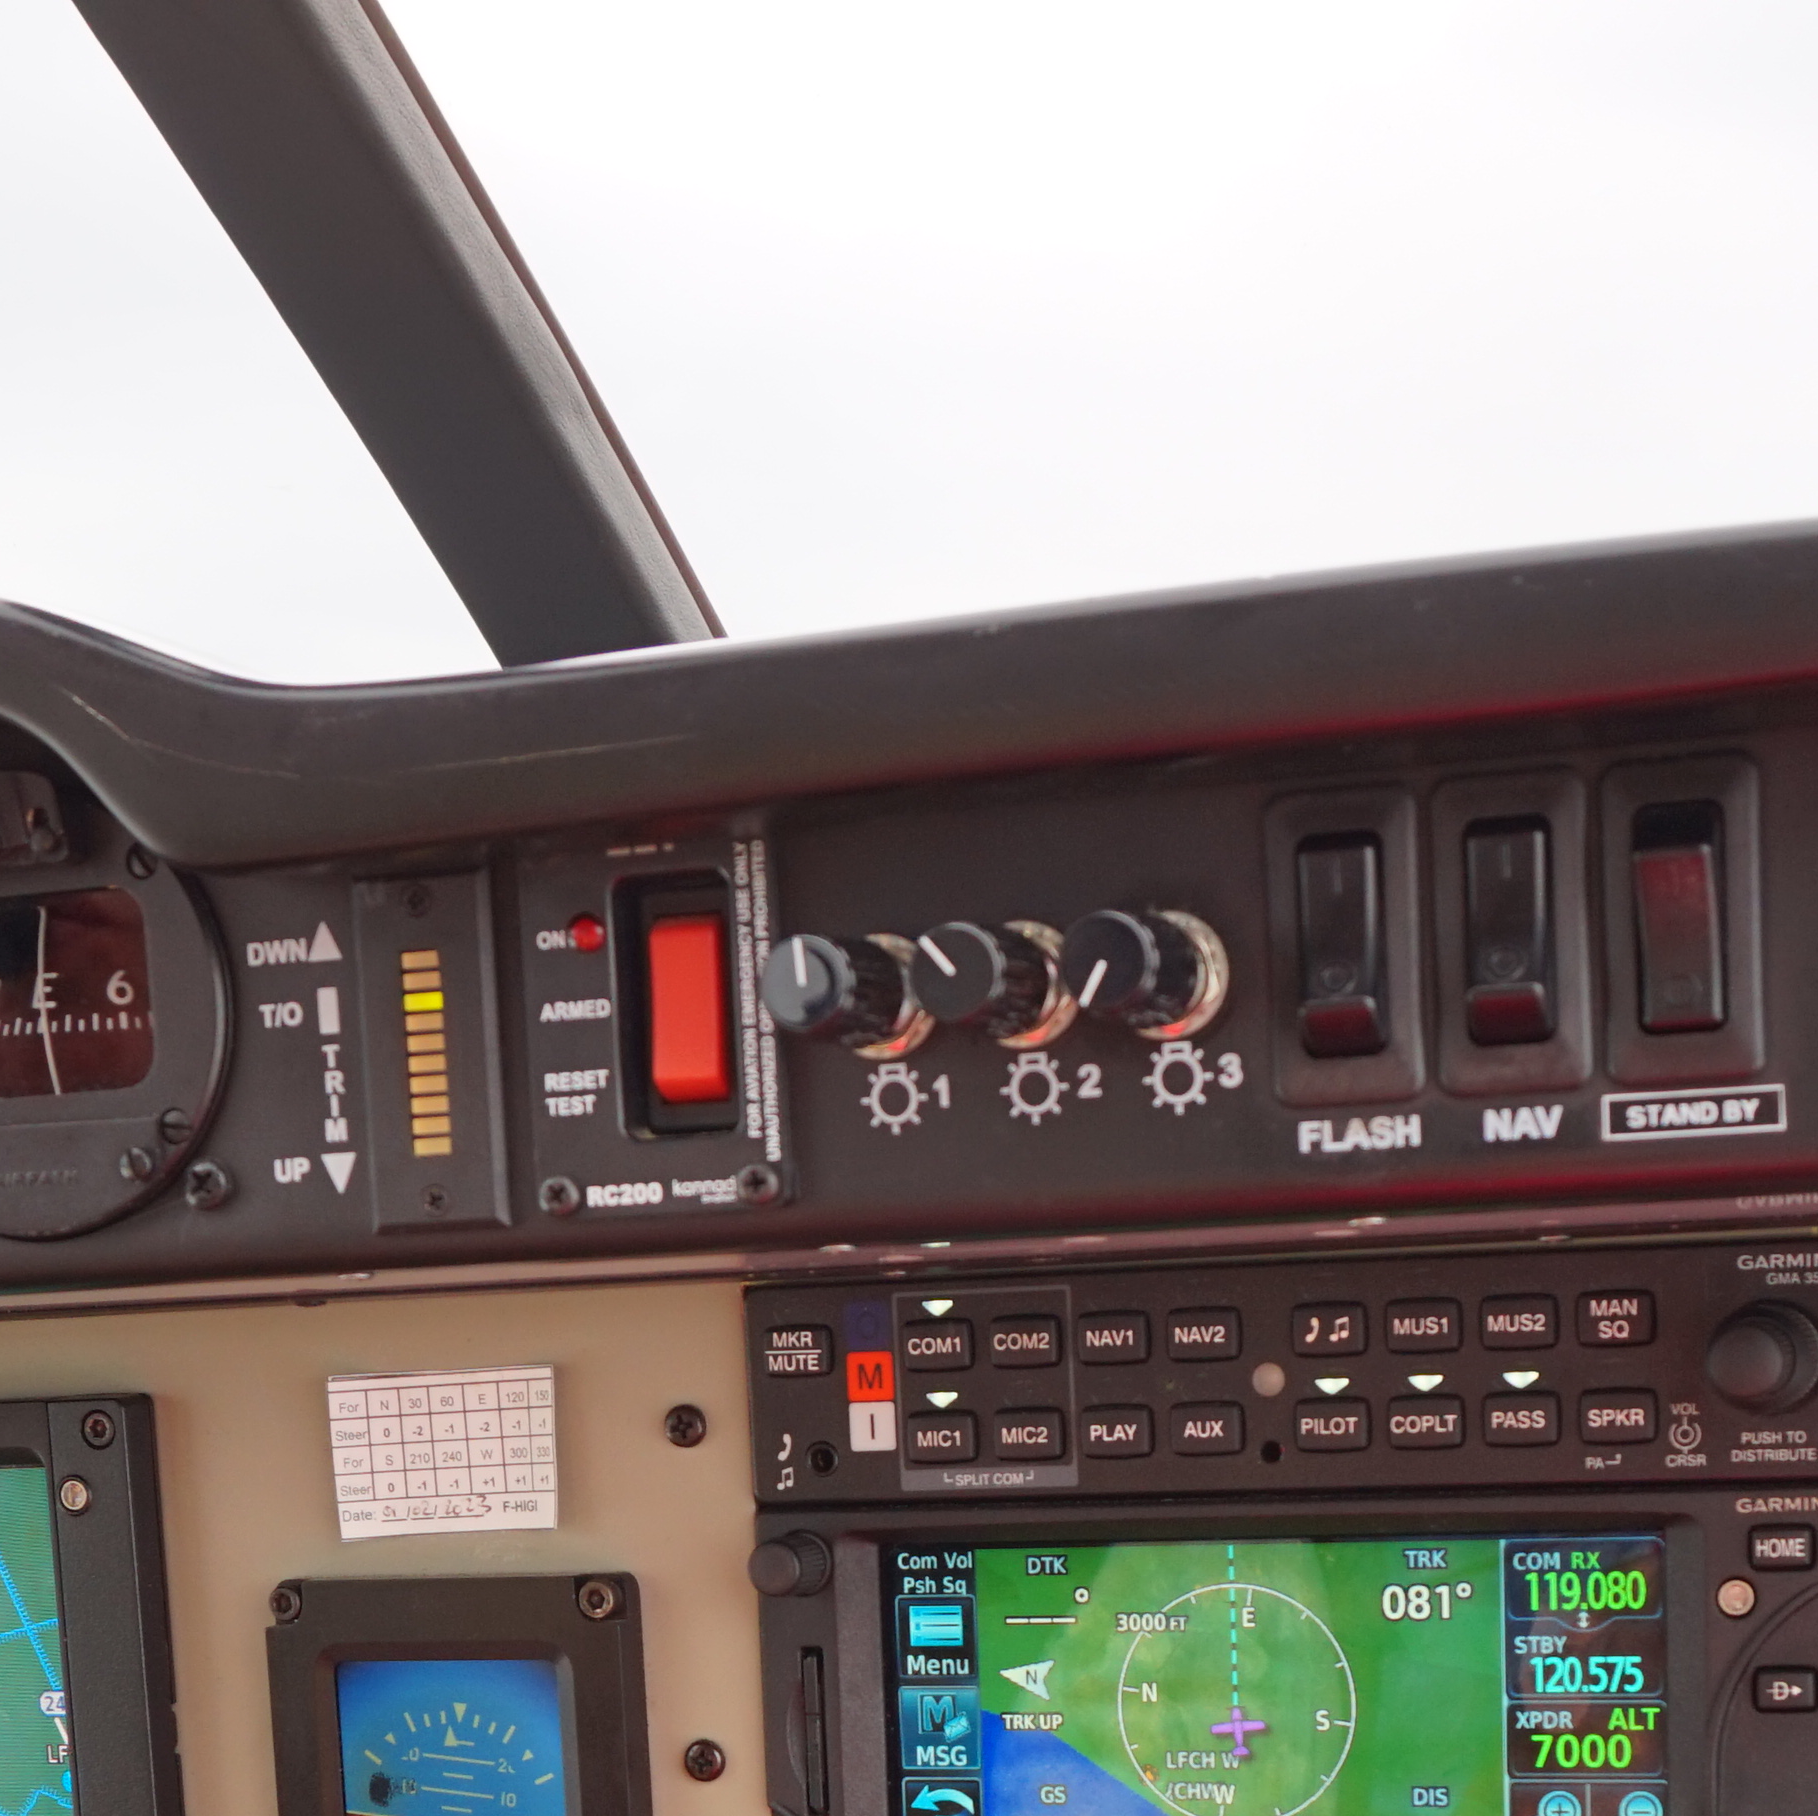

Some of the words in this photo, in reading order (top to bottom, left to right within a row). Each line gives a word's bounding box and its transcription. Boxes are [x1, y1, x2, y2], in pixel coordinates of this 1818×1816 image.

[733, 842, 749, 886] ONLY
[736, 888, 751, 923] USE
[247, 941, 307, 966] DWN
[738, 925, 757, 1026] EMERGENCY
[259, 1003, 303, 1028] T/O
[540, 1000, 611, 1022] ARMED
[743, 1028, 762, 1100] AVIATION
[545, 1070, 609, 1092] RESET
[546, 1096, 596, 1117] TEST
[1627, 1103, 1717, 1126] STAND
[1722, 1100, 1759, 1123] BY
[747, 1103, 763, 1139] FOR
[1484, 1106, 1562, 1142] NAV
[1299, 1116, 1421, 1153] FLASH
[274, 1159, 310, 1183] UP
[587, 1184, 663, 1207] RC200
[773, 1332, 812, 1347] MKR
[993, 1333, 1049, 1350] COM2
[1086, 1331, 1134, 1346] NAV1
[1174, 1327, 1225, 1343] NAV2
[908, 1338, 961, 1355] COM1
[769, 1355, 819, 1371] MUTE
[1184, 1422, 1224, 1438] AUX
[1301, 1418, 1358, 1436] PILOT
[1391, 1414, 1457, 1434] COPLT
[917, 1430, 961, 1447] MIC1
[1002, 1427, 1048, 1444] MIC2
[1755, 1539, 1805, 1558] HOME
[1525, 1571, 1647, 1611] 119.080
[907, 1655, 969, 1675] Menu
[1530, 1656, 1644, 1693] 120.575
[1515, 1712, 1573, 1729] XPDR
[1608, 1708, 1660, 1730] ALT
[916, 1745, 967, 1766] MSG
[1531, 1735, 1633, 1768] 7000
